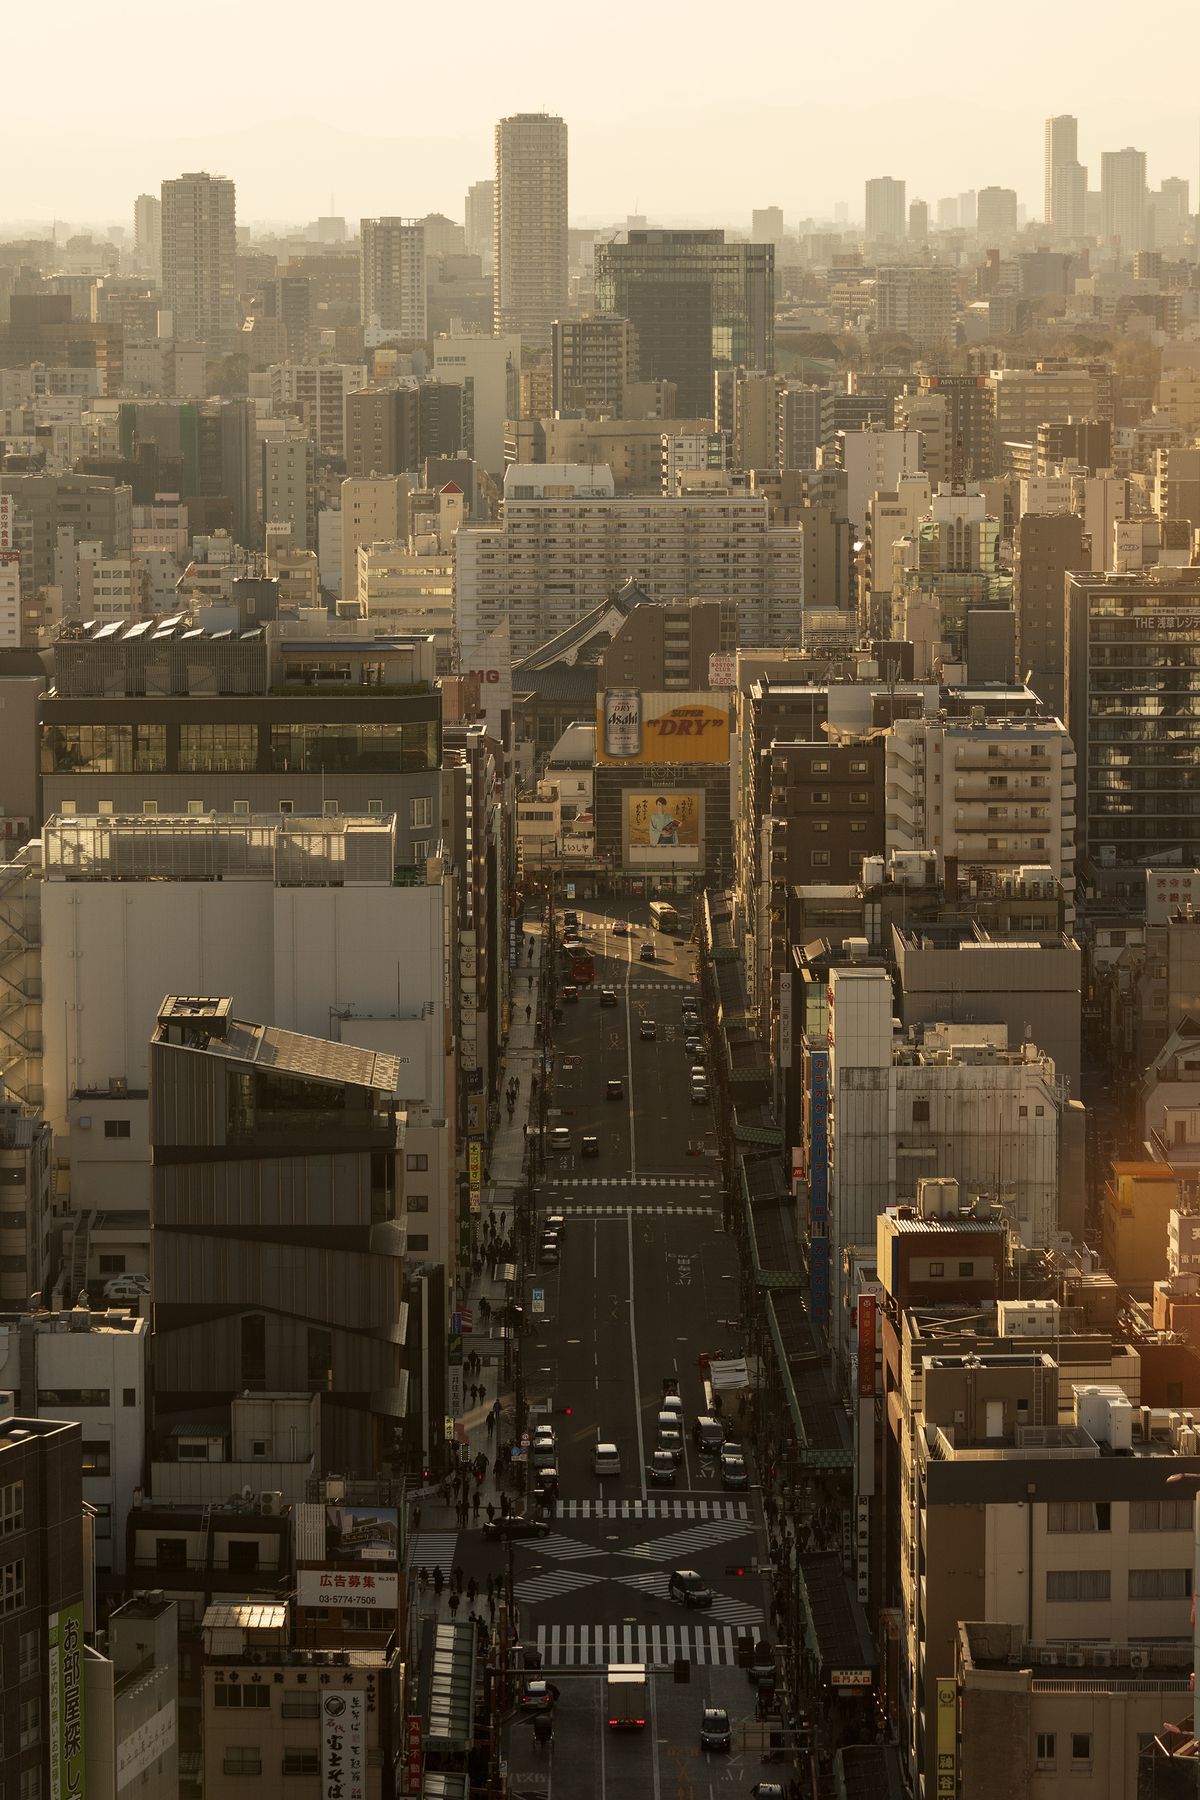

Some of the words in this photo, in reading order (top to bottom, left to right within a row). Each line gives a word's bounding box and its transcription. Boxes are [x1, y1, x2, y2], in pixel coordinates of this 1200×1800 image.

[1134, 617, 1154, 628] THE
[608, 712, 638, 725] Asahi
[320, 1574, 376, 1588] 広告募集
[319, 1594, 377, 1605] 03-5774-7506
[832, 1676, 870, 1684] 雷門入口
[63, 1617, 83, 1800] お部屋探し
[326, 1735, 345, 1799] 富士そば
